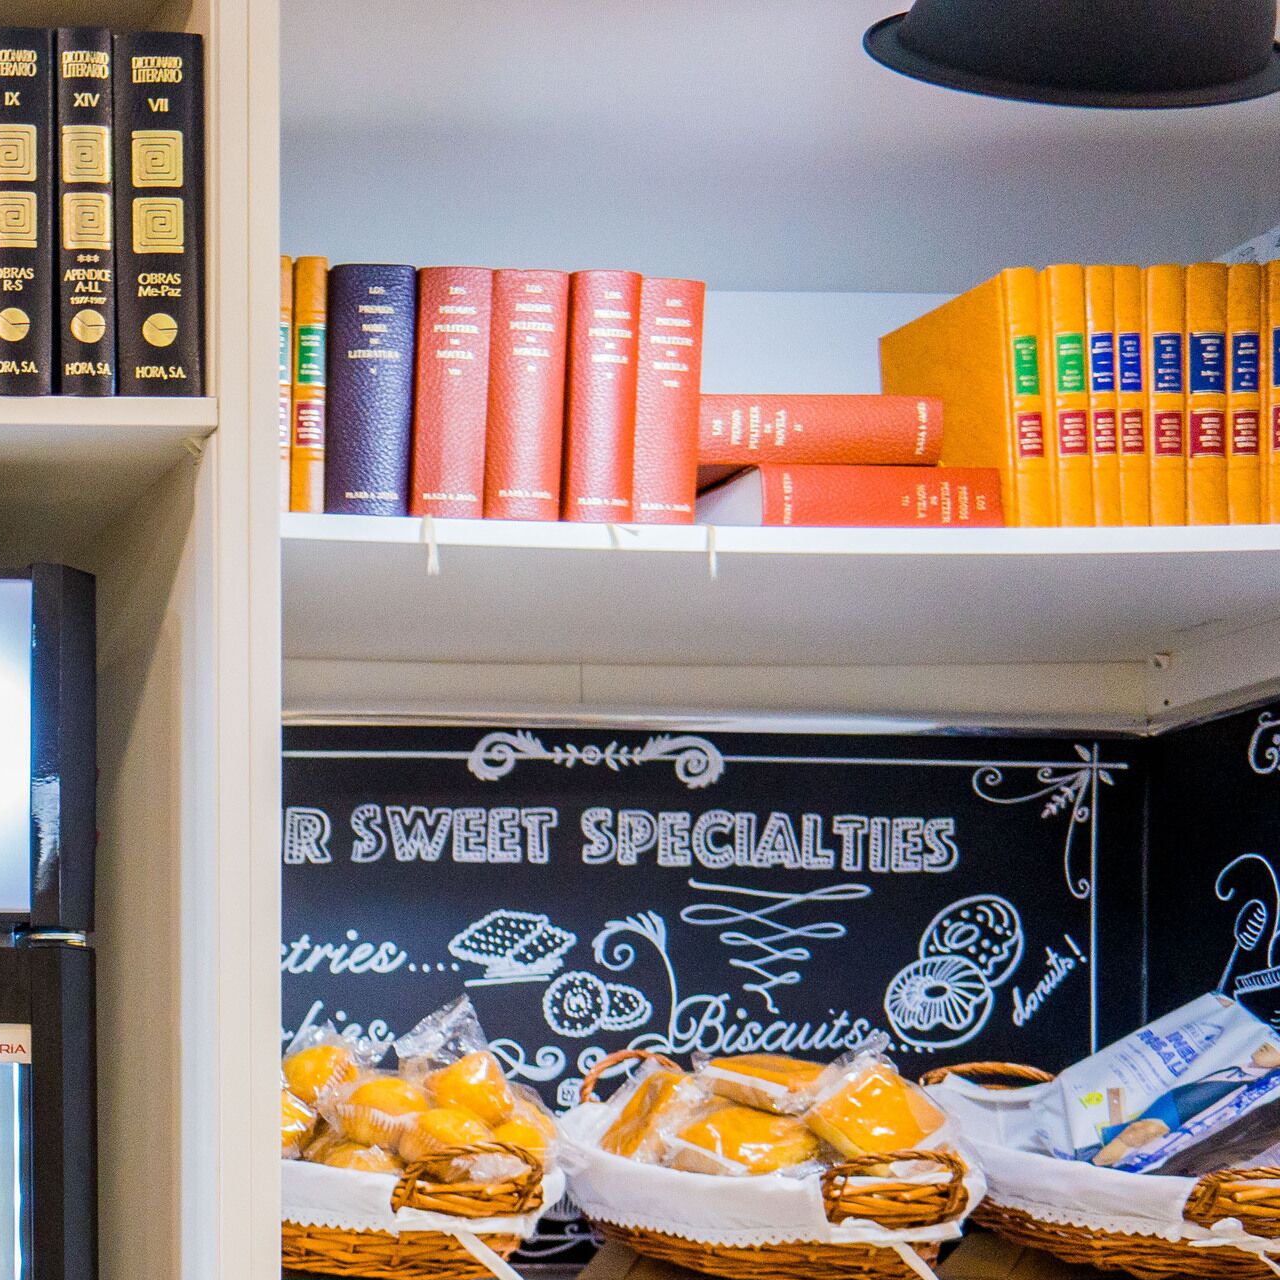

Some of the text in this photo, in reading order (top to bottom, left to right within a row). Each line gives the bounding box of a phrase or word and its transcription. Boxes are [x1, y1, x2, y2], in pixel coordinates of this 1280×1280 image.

[63, 64, 109, 79] LITERARIO
[132, 69, 182, 83] LITERARIO
[4, 92, 20, 106] IX
[73, 93, 99, 107] XIV
[148, 98, 168, 111] VII
[138, 273, 181, 285] OBRAS
[350, 804, 558, 864] SWEET
[580, 808, 960, 873] SPECIALTIES
